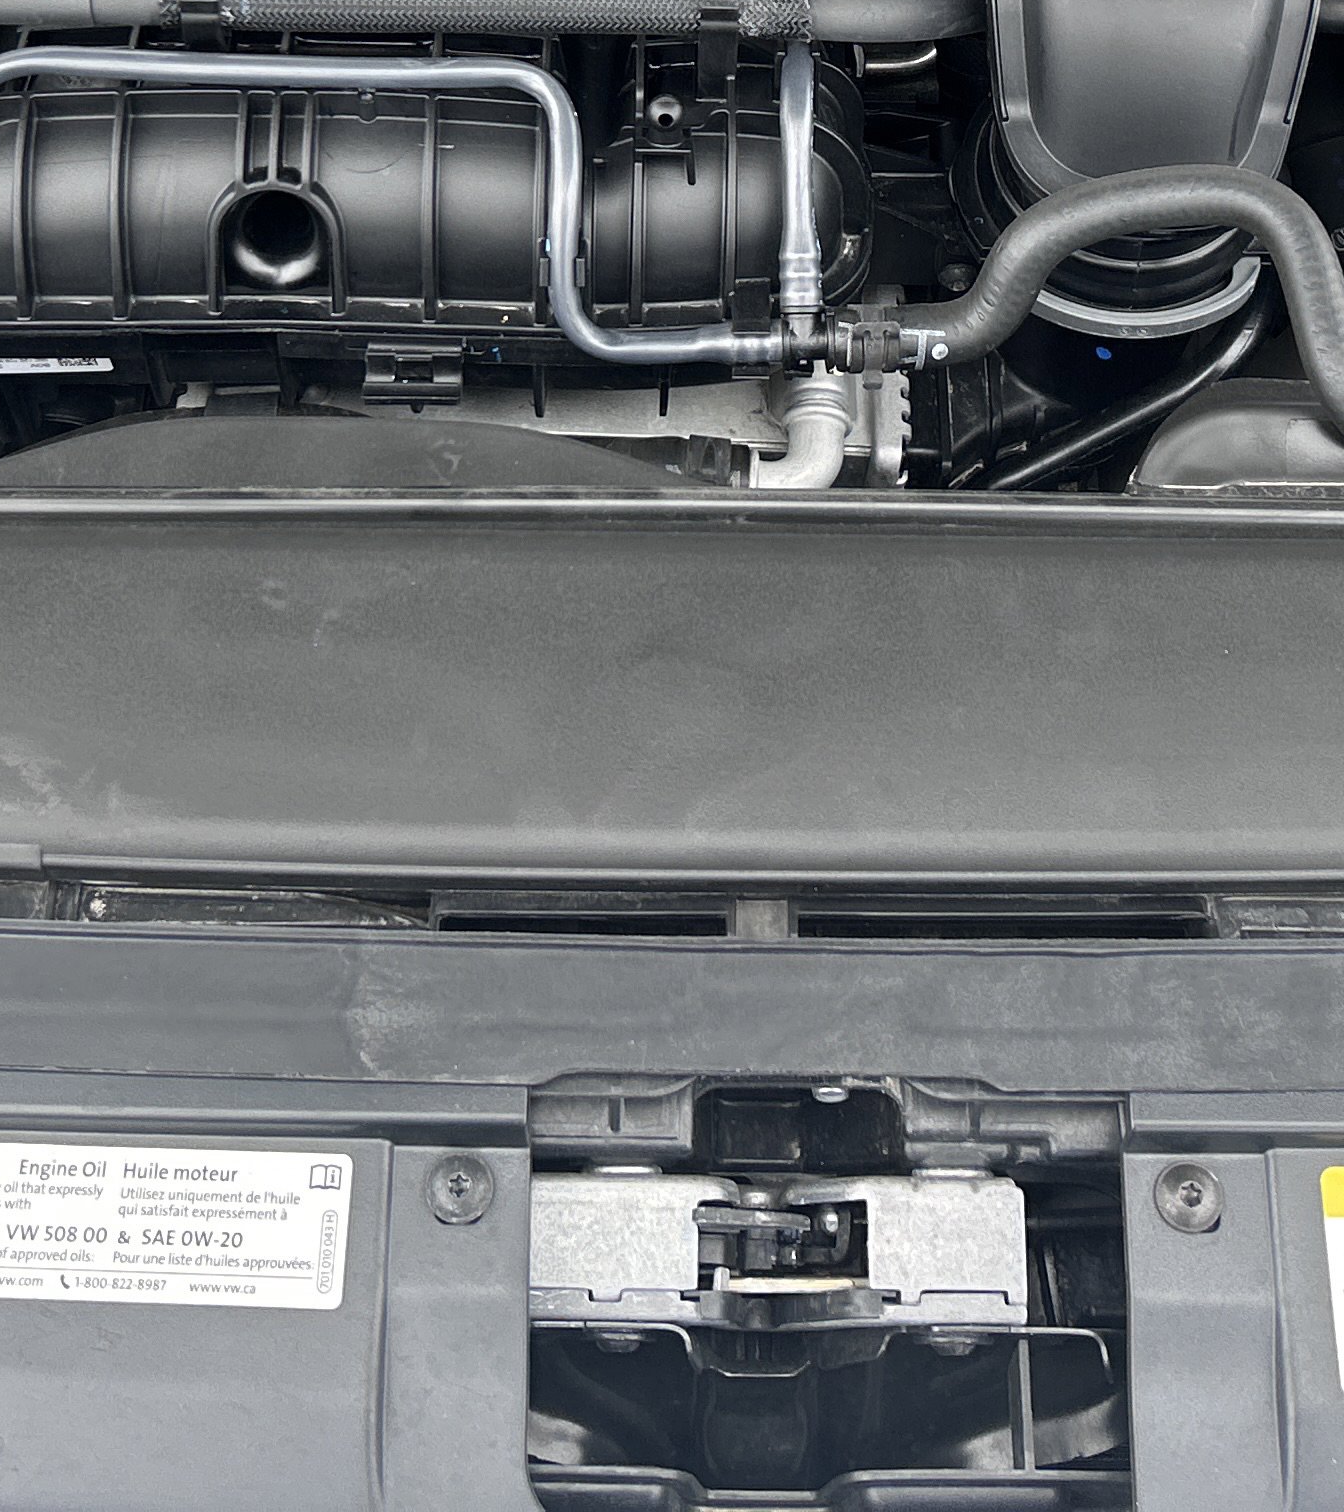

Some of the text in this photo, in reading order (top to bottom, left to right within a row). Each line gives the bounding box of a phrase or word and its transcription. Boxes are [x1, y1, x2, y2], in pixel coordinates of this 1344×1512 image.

[19, 1159, 238, 1182] Engine Oil Huile moteur
[4, 1182, 18, 1193] oil
[22, 1183, 45, 1194] that
[48, 1184, 103, 1199] expressly
[121, 1187, 300, 1205] Utilisez uniquement de l'huile
[5, 1199, 31, 1209] with
[118, 1204, 288, 1221] qui satisfait expressément à
[326, 1214, 335, 1223] H
[6, 1224, 243, 1248] VW 508 00 & SAE 0W-20
[10, 1249, 67, 1262] approved
[70, 1250, 94, 1262] oils:
[113, 1251, 140, 1263] Pour
[143, 1254, 165, 1264] une
[168, 1253, 192, 1266] liste
[195, 1254, 240, 1267] d'huiles
[322, 1249, 332, 1269] 010
[319, 1274, 330, 1288] 701
